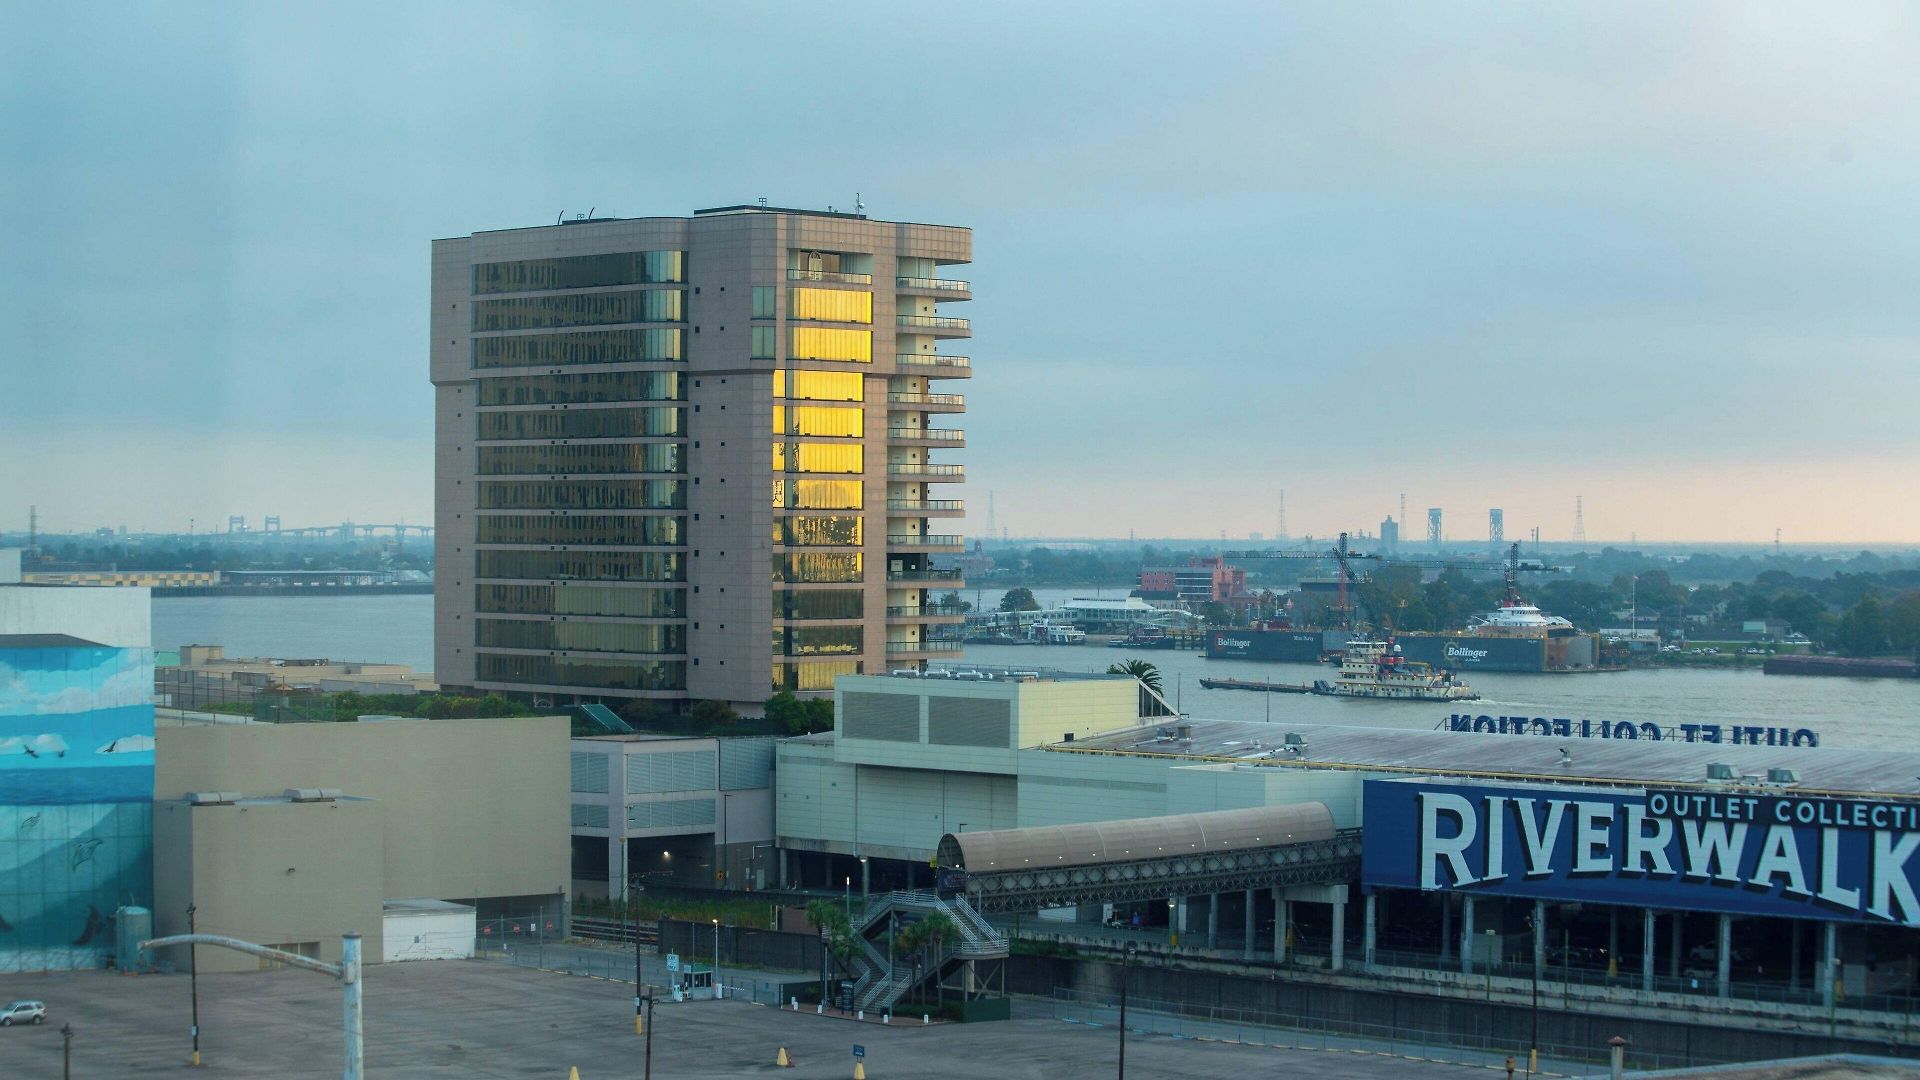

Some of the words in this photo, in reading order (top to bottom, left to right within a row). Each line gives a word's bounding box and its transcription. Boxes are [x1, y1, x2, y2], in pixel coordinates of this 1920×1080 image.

[1217, 637, 1252, 649] Bollinger
[1447, 647, 1488, 659] Bollinger
[1650, 793, 1759, 821] OUTLET
[1775, 800, 1918, 830] COLLECTI
[1418, 791, 1920, 928] RIVERWALK
